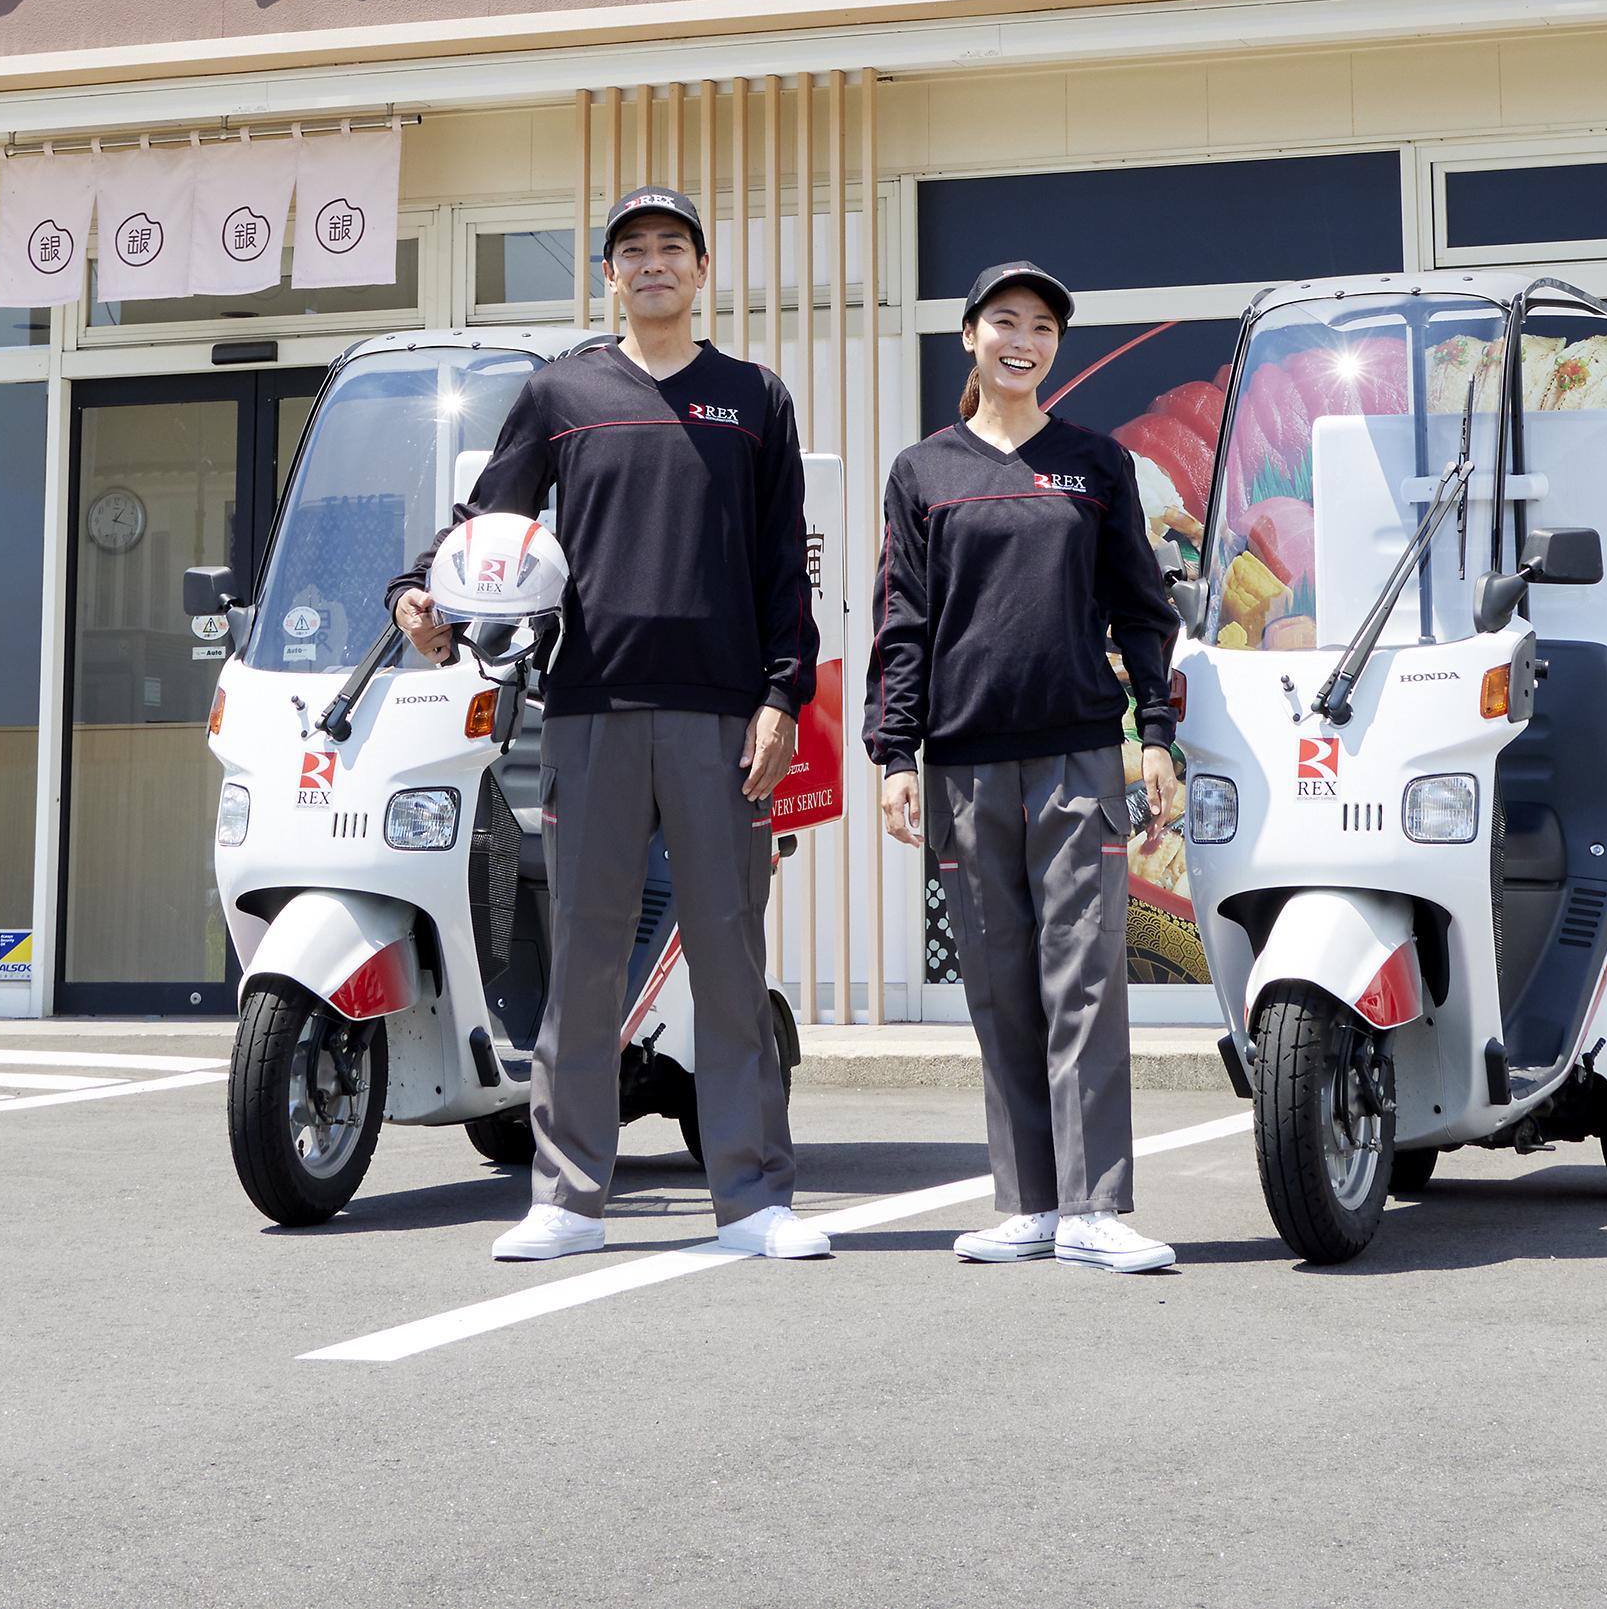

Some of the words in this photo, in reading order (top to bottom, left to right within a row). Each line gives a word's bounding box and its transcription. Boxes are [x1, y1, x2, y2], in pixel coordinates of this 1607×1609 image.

[640, 194, 675, 205] REX
[234, 222, 257, 249] 銀
[328, 214, 352, 242] 銀
[128, 228, 150, 254] 銀
[40, 236, 61, 263] 銀
[705, 405, 739, 421] REX
[1051, 474, 1086, 489] REX
[477, 582, 503, 593] REX
[206, 649, 223, 657] Auto
[286, 647, 303, 655] Auto
[1400, 671, 1461, 683] HONDA
[395, 695, 450, 704] HONDA
[1297, 780, 1337, 796] REX
[297, 790, 332, 805] REX
[772, 796, 795, 817] VERY
[797, 788, 833, 812] SERVICE
